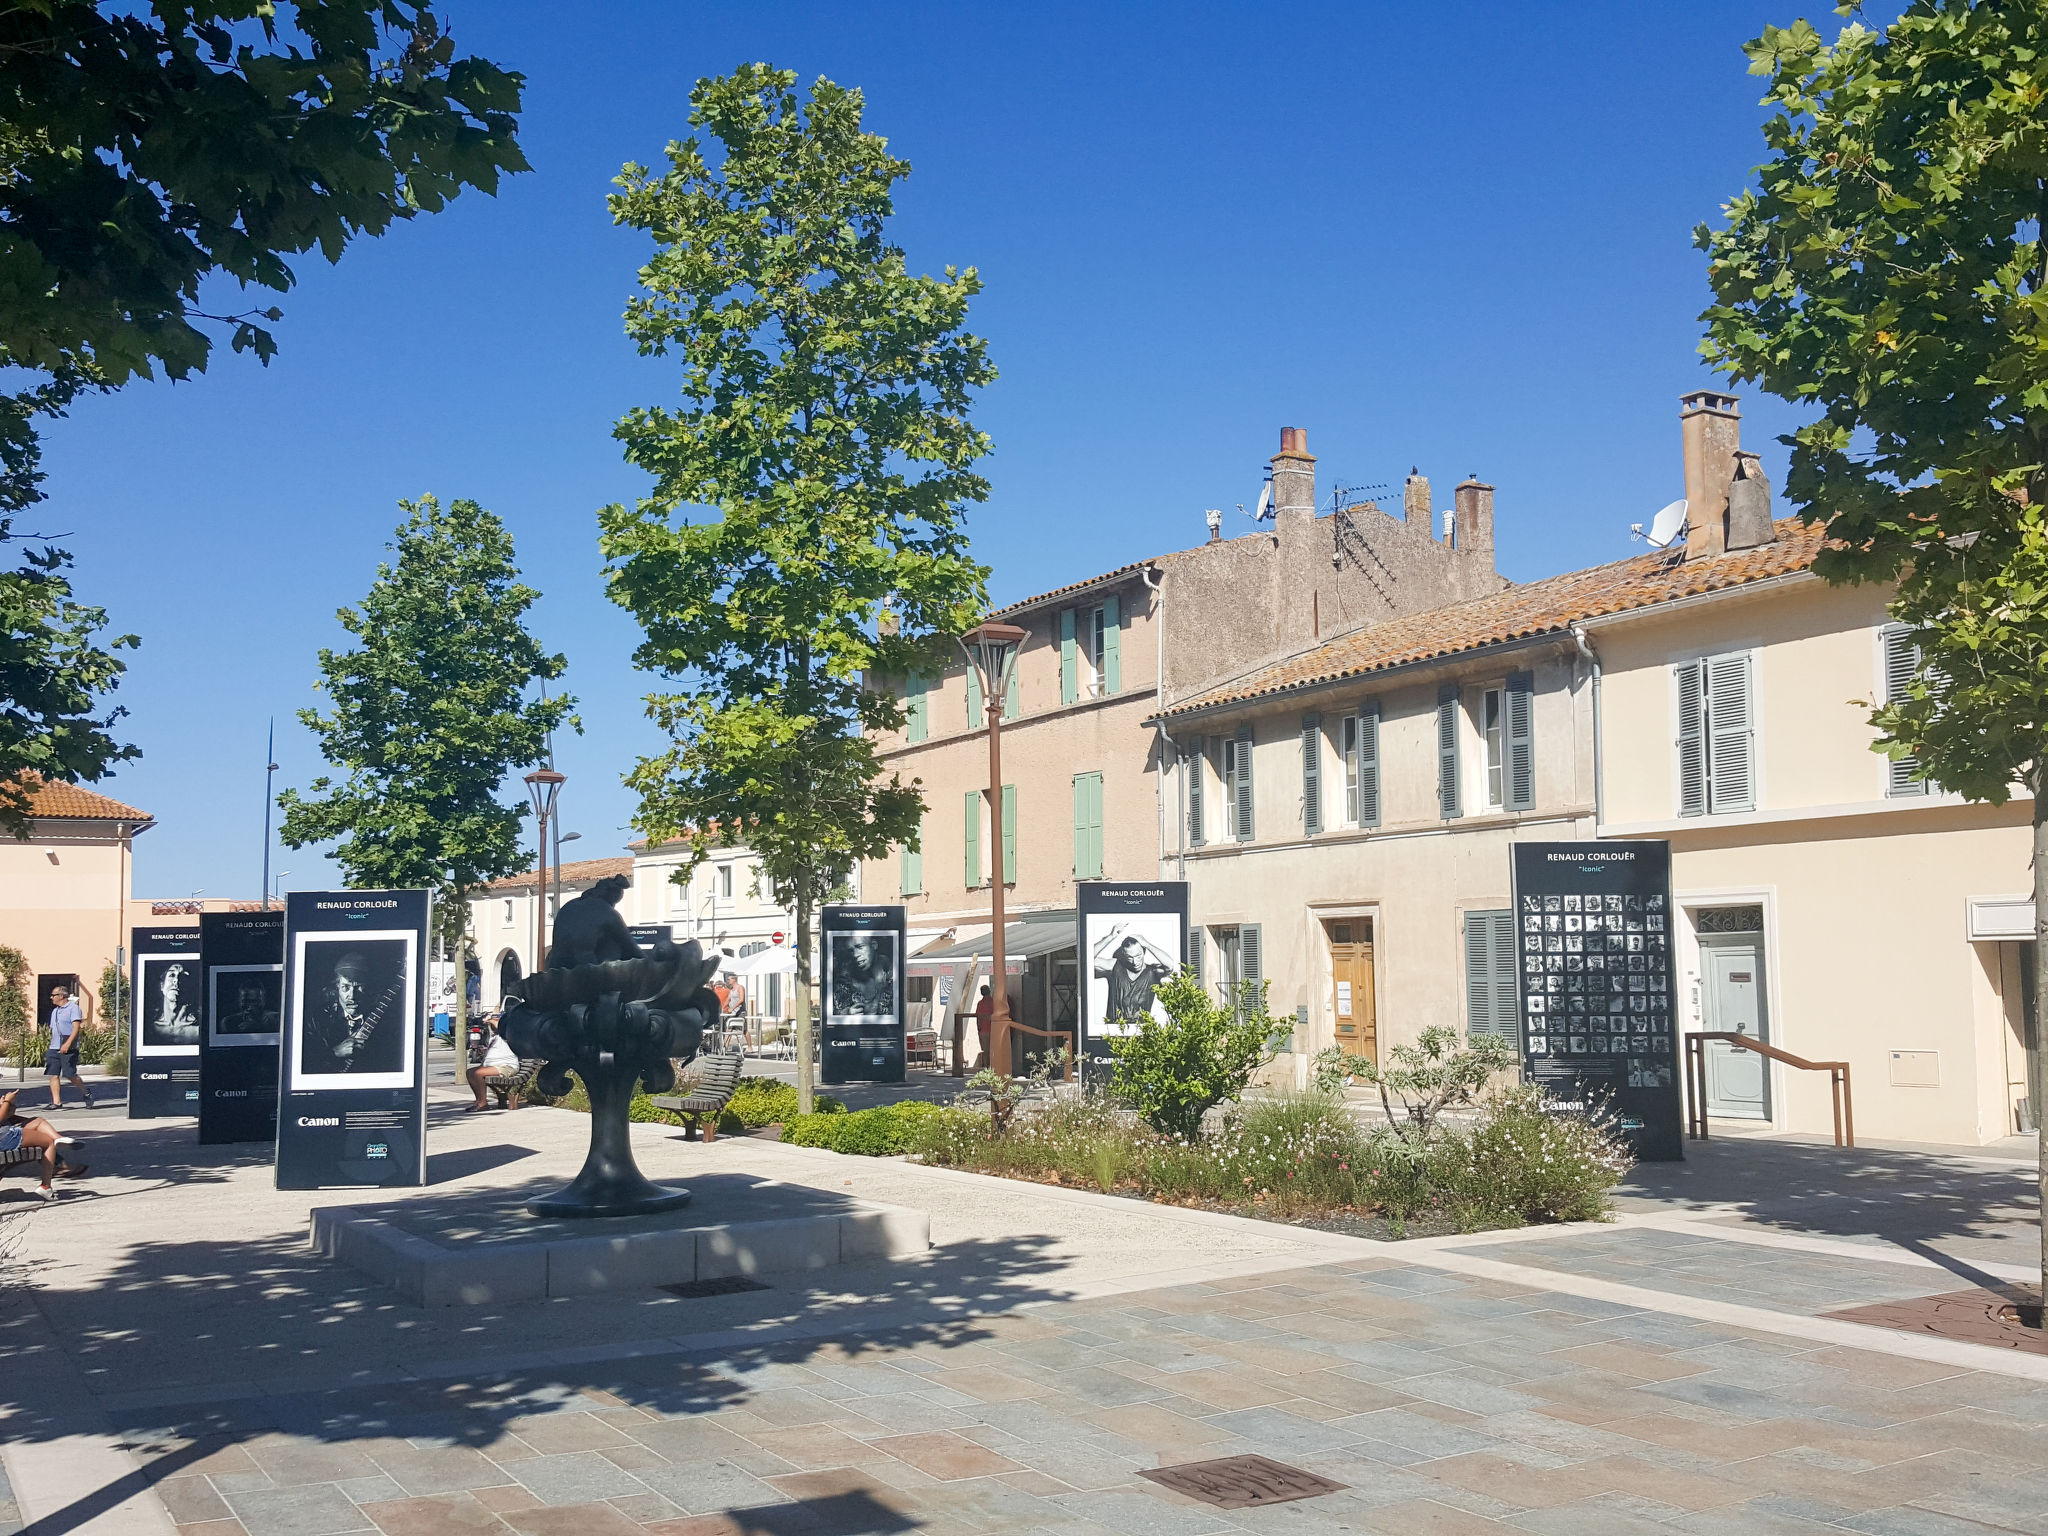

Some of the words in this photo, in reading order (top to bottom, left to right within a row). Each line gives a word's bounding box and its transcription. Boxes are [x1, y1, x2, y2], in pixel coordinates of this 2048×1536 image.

[1547, 853, 1585, 861] RENAUD
[317, 900, 352, 909] RENAUD
[225, 921, 254, 929] RENAUD
[254, 920, 283, 929] CORLOU
[140, 1072, 168, 1080] Canon
[214, 1089, 248, 1098] Canon
[1538, 1100, 1584, 1111] Canon
[297, 1116, 340, 1127] Canon
